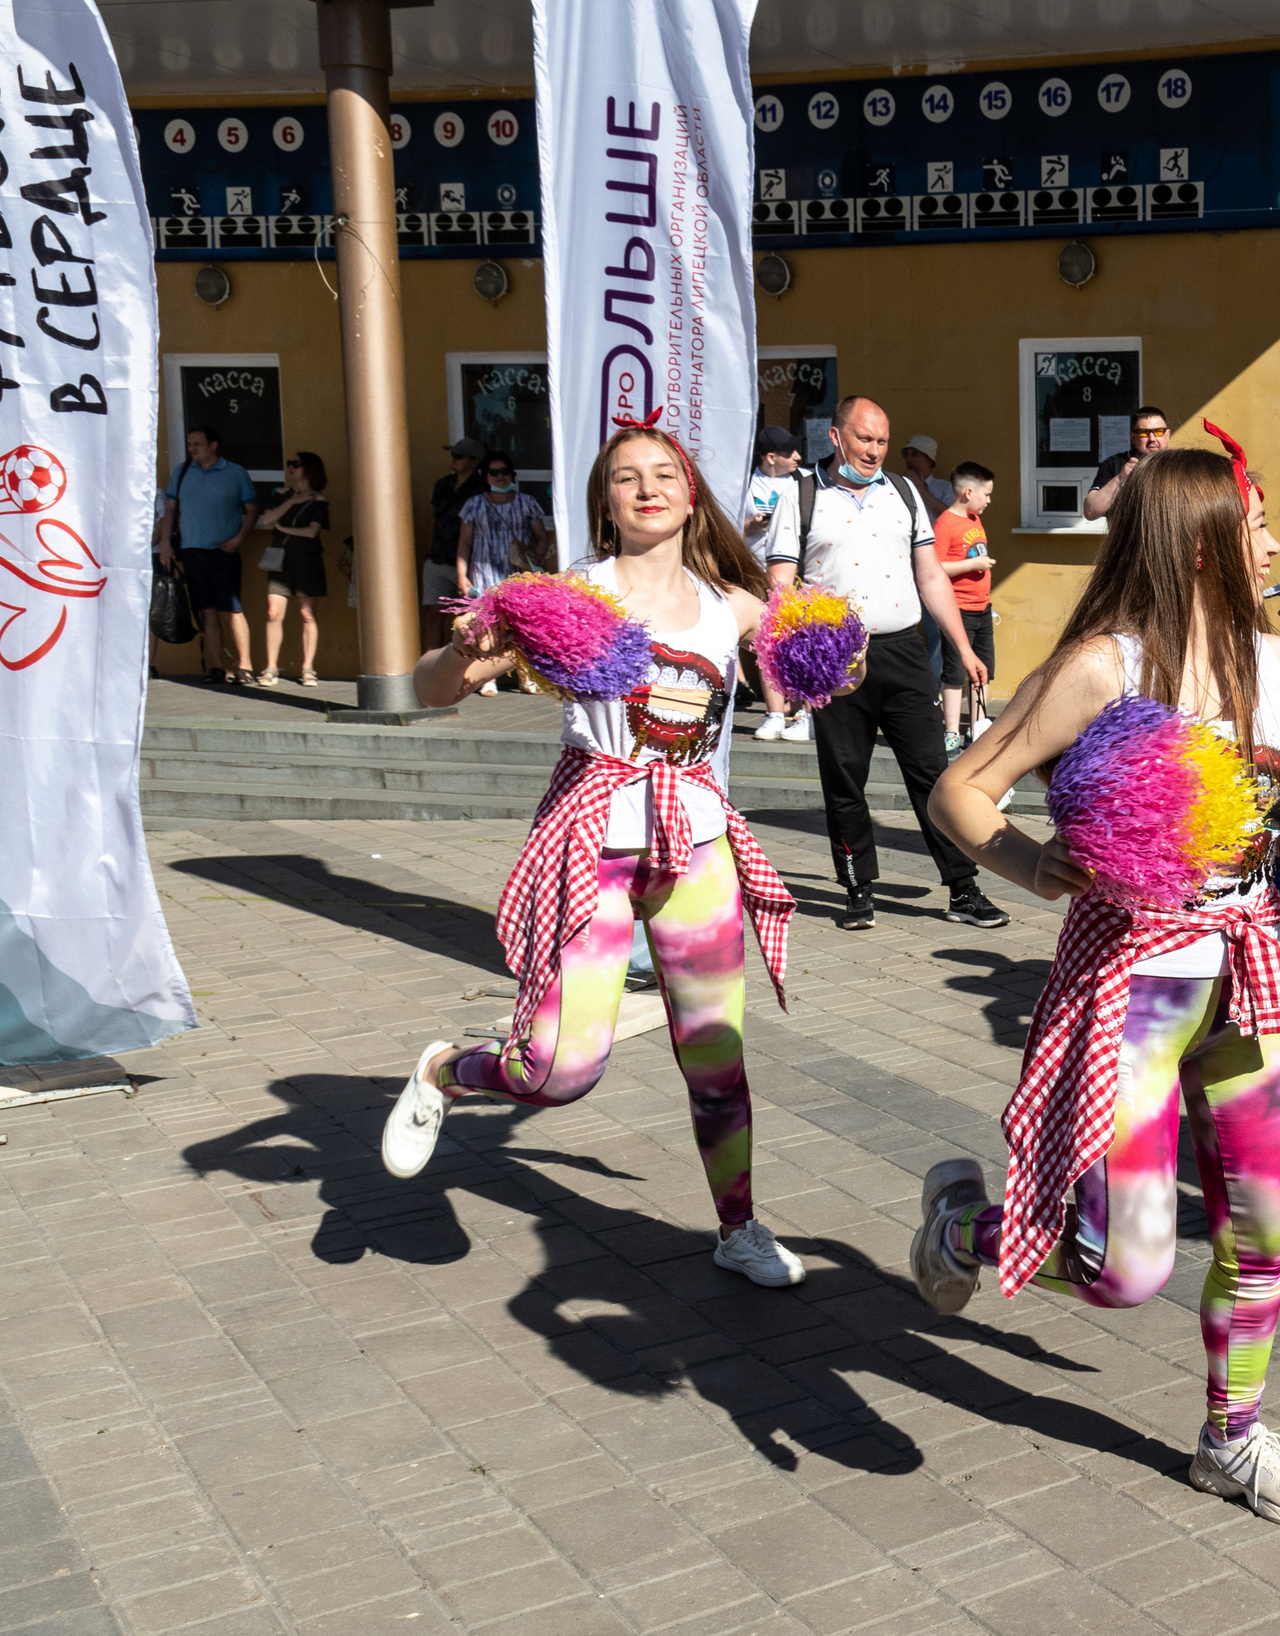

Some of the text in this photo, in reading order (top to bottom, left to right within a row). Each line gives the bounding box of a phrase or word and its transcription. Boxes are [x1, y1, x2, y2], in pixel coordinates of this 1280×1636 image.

[172, 128, 186, 147] 4
[226, 126, 240, 146] 5
[282, 125, 296, 145] 6
[443, 121, 456, 140] 9
[491, 118, 515, 138] 10
[757, 103, 777, 123] 11
[812, 100, 835, 120] 12
[868, 97, 891, 117] 13
[925, 93, 949, 114] 14
[983, 90, 1007, 110] 15
[1041, 86, 1067, 107] 16
[1101, 82, 1125, 103] 17
[1161, 77, 1187, 99] 18
[693, 108, 709, 199] ОБЛАСТИ
[670, 104, 691, 247] ОРГАНИЗАЦИЙ
[16, 62, 107, 414] В СЕРДЦЕ
[691, 204, 709, 311] ЛИПЕЦКОЙ
[229, 400, 239, 413] 5
[508, 397, 516, 410] 6
[689, 317, 705, 442] ГУБЕРНАТОРА
[1082, 387, 1092, 402] 8
